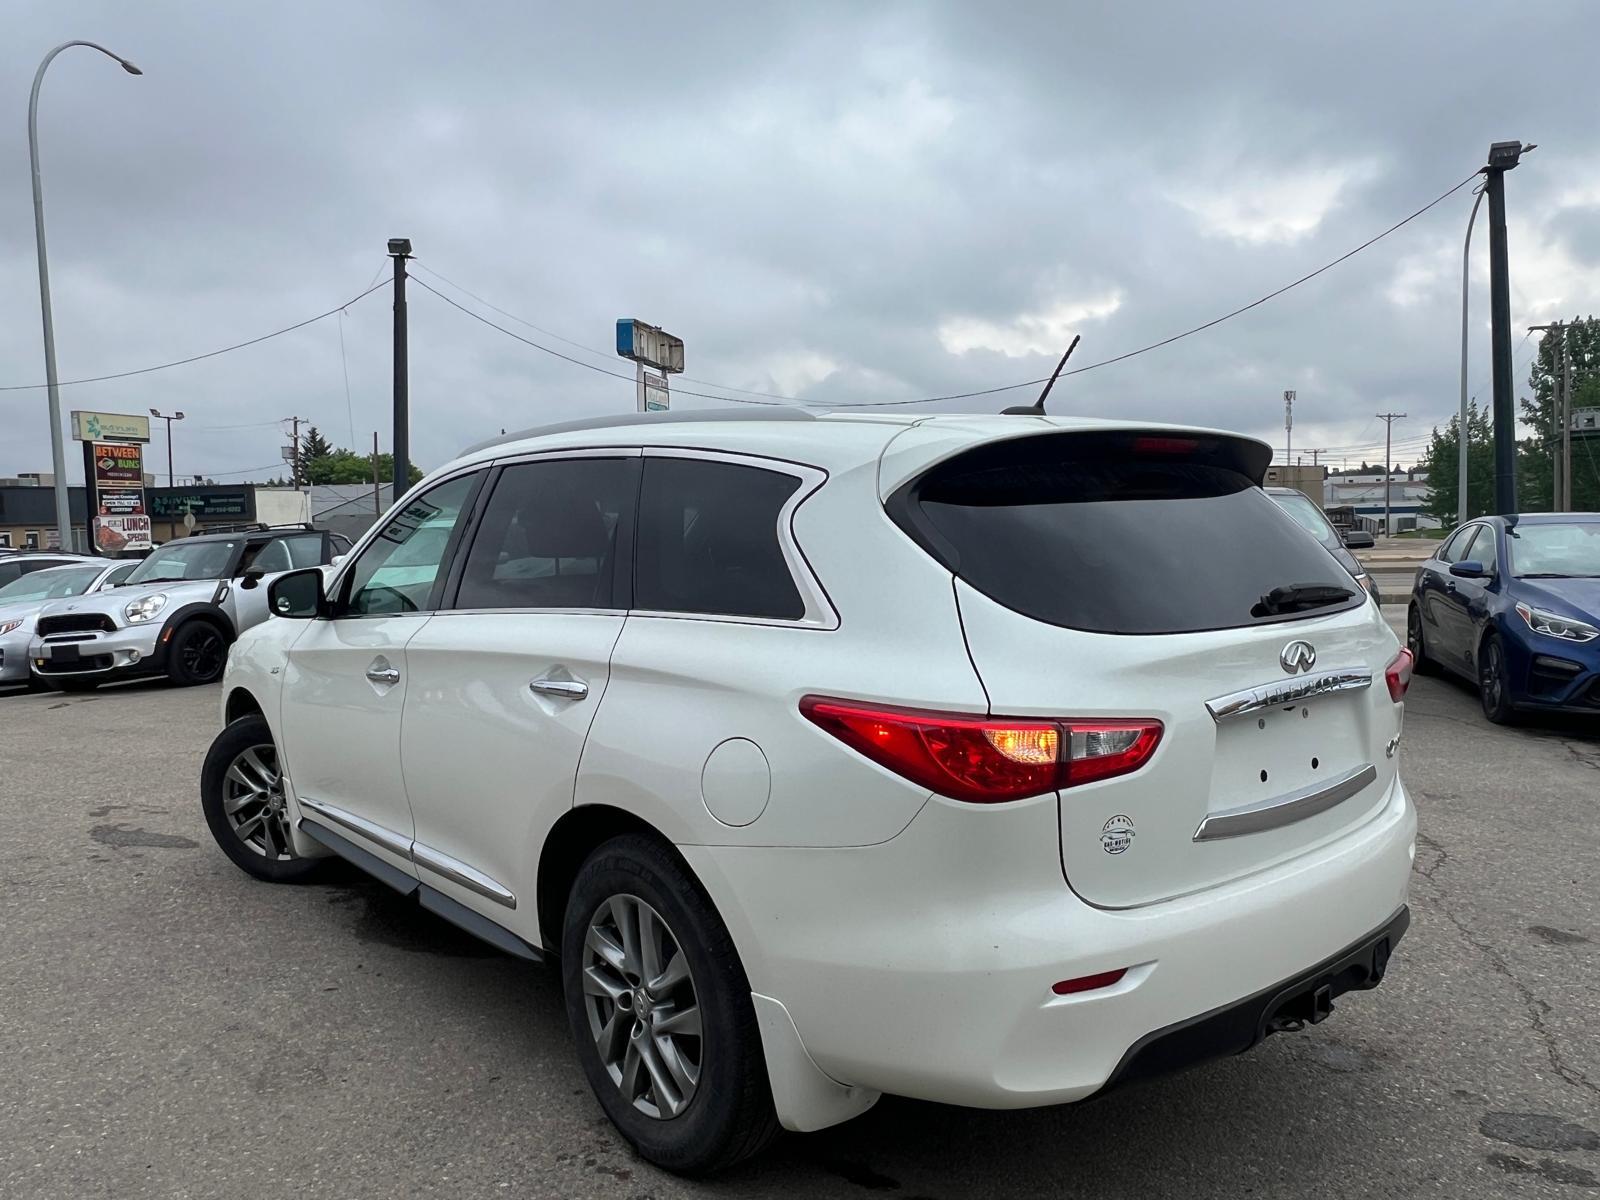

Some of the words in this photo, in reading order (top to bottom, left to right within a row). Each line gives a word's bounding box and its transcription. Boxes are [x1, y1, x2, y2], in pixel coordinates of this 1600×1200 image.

[96, 446, 140, 458] BETWEEN
[117, 459, 140, 469] BUNS
[122, 517, 149, 531] LUNCH
[127, 533, 149, 542] SPECIAL
